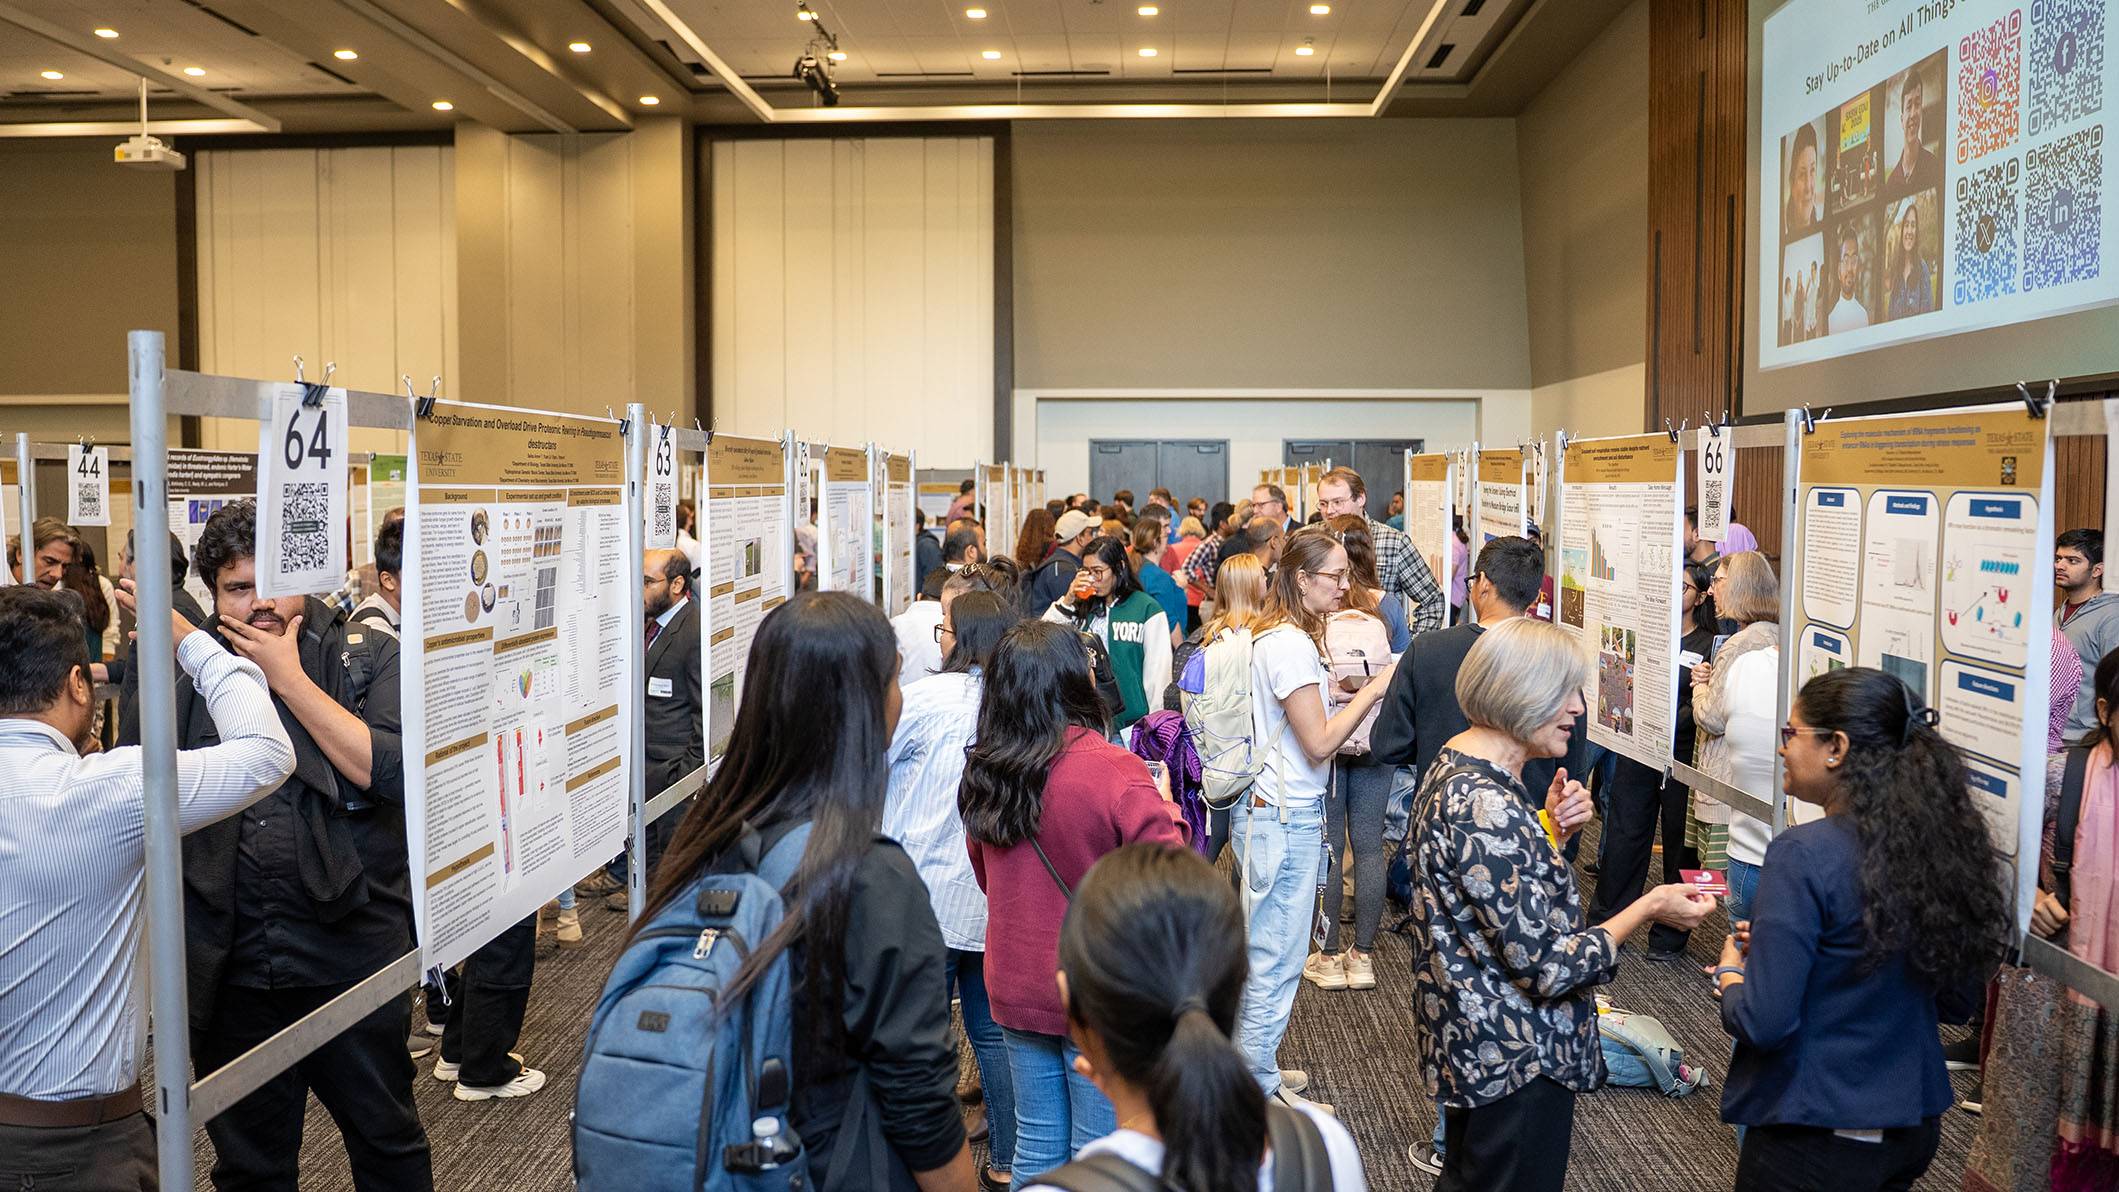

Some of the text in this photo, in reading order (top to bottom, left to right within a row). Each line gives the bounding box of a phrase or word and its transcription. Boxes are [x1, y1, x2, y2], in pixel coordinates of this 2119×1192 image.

[1806, 73, 1824, 95] Stay
[1826, 39, 1879, 83] Up-to-Date
[1882, 30, 1896, 49] on
[1899, 13, 1913, 40] All
[453, 414, 482, 428] Starvation
[483, 419, 495, 429] and
[496, 419, 522, 431] Overload
[523, 421, 537, 432] Drive
[538, 422, 561, 434] Proteomic
[284, 409, 331, 470] 64
[78, 455, 101, 479] 44
[444, 451, 463, 463] STATE
[656, 440, 671, 476] 63
[1705, 441, 1722, 473] 66
[444, 492, 468, 501] Background
